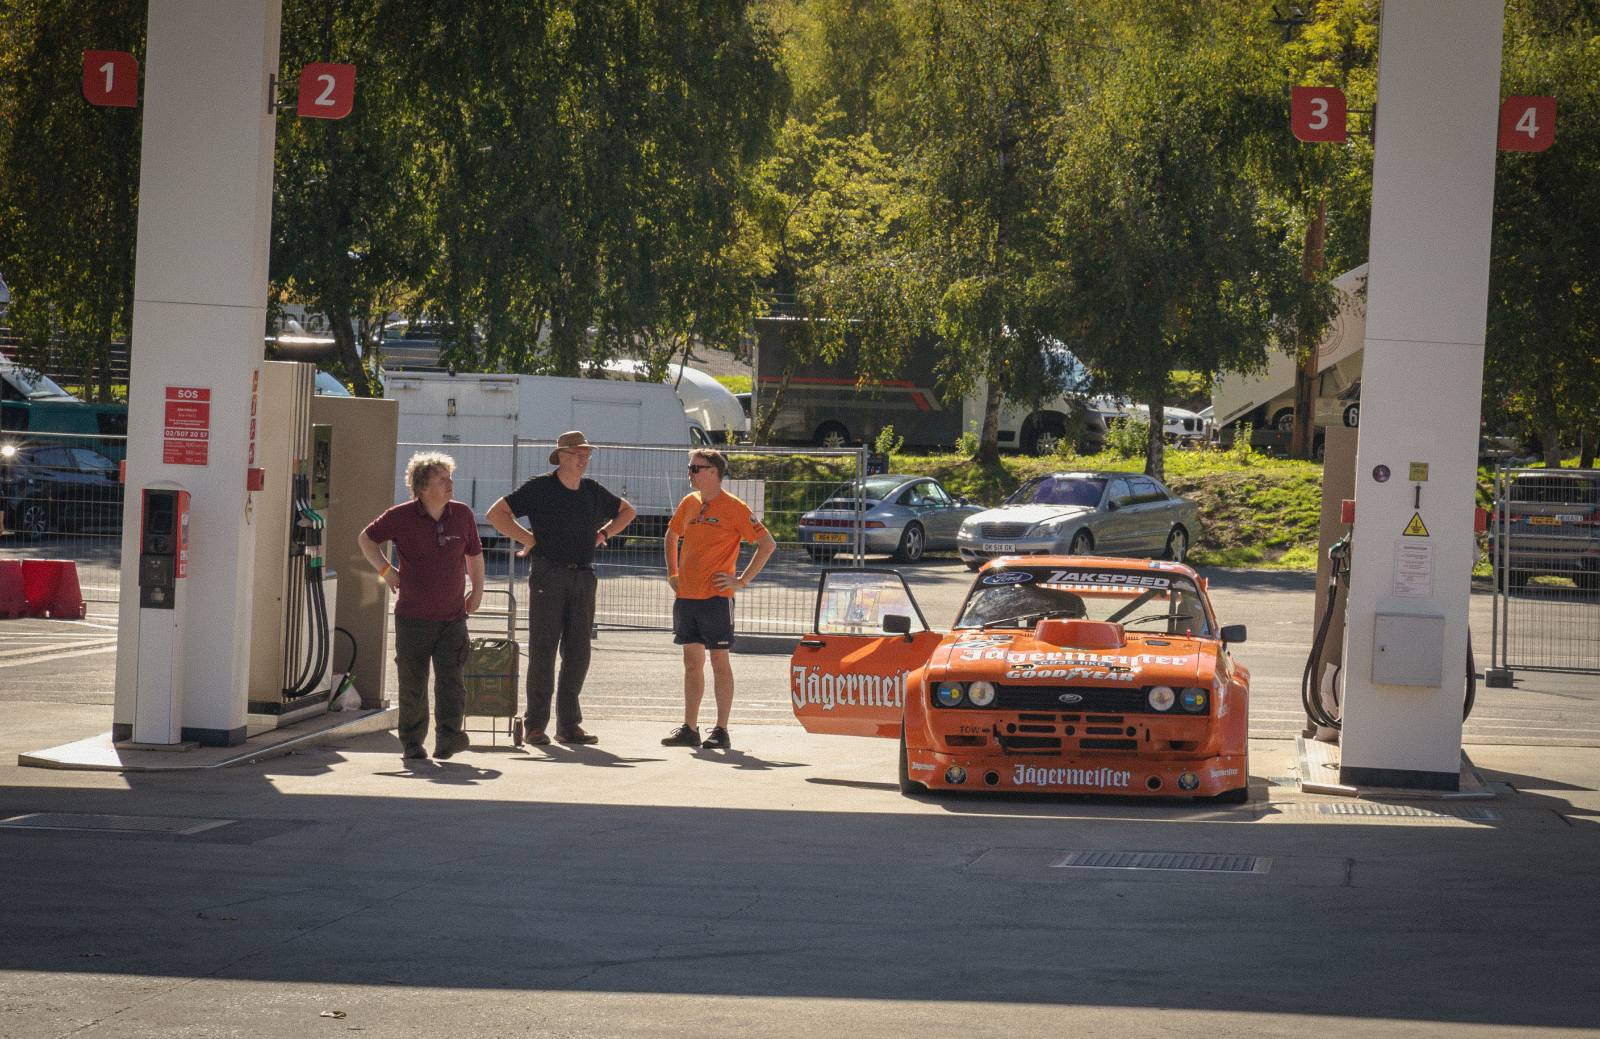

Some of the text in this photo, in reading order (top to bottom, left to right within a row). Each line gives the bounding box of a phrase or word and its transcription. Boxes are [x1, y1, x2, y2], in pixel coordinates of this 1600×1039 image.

[99, 62, 114, 93] 1
[314, 74, 336, 106] 2
[1308, 98, 1329, 131] 3
[1515, 107, 1540, 140] 4
[177, 389, 199, 399] SOS
[1047, 570, 1170, 589] ZAKSPEED
[1006, 667, 1135, 681] GOODYEAR
[1013, 764, 1130, 788] Jägermeister
